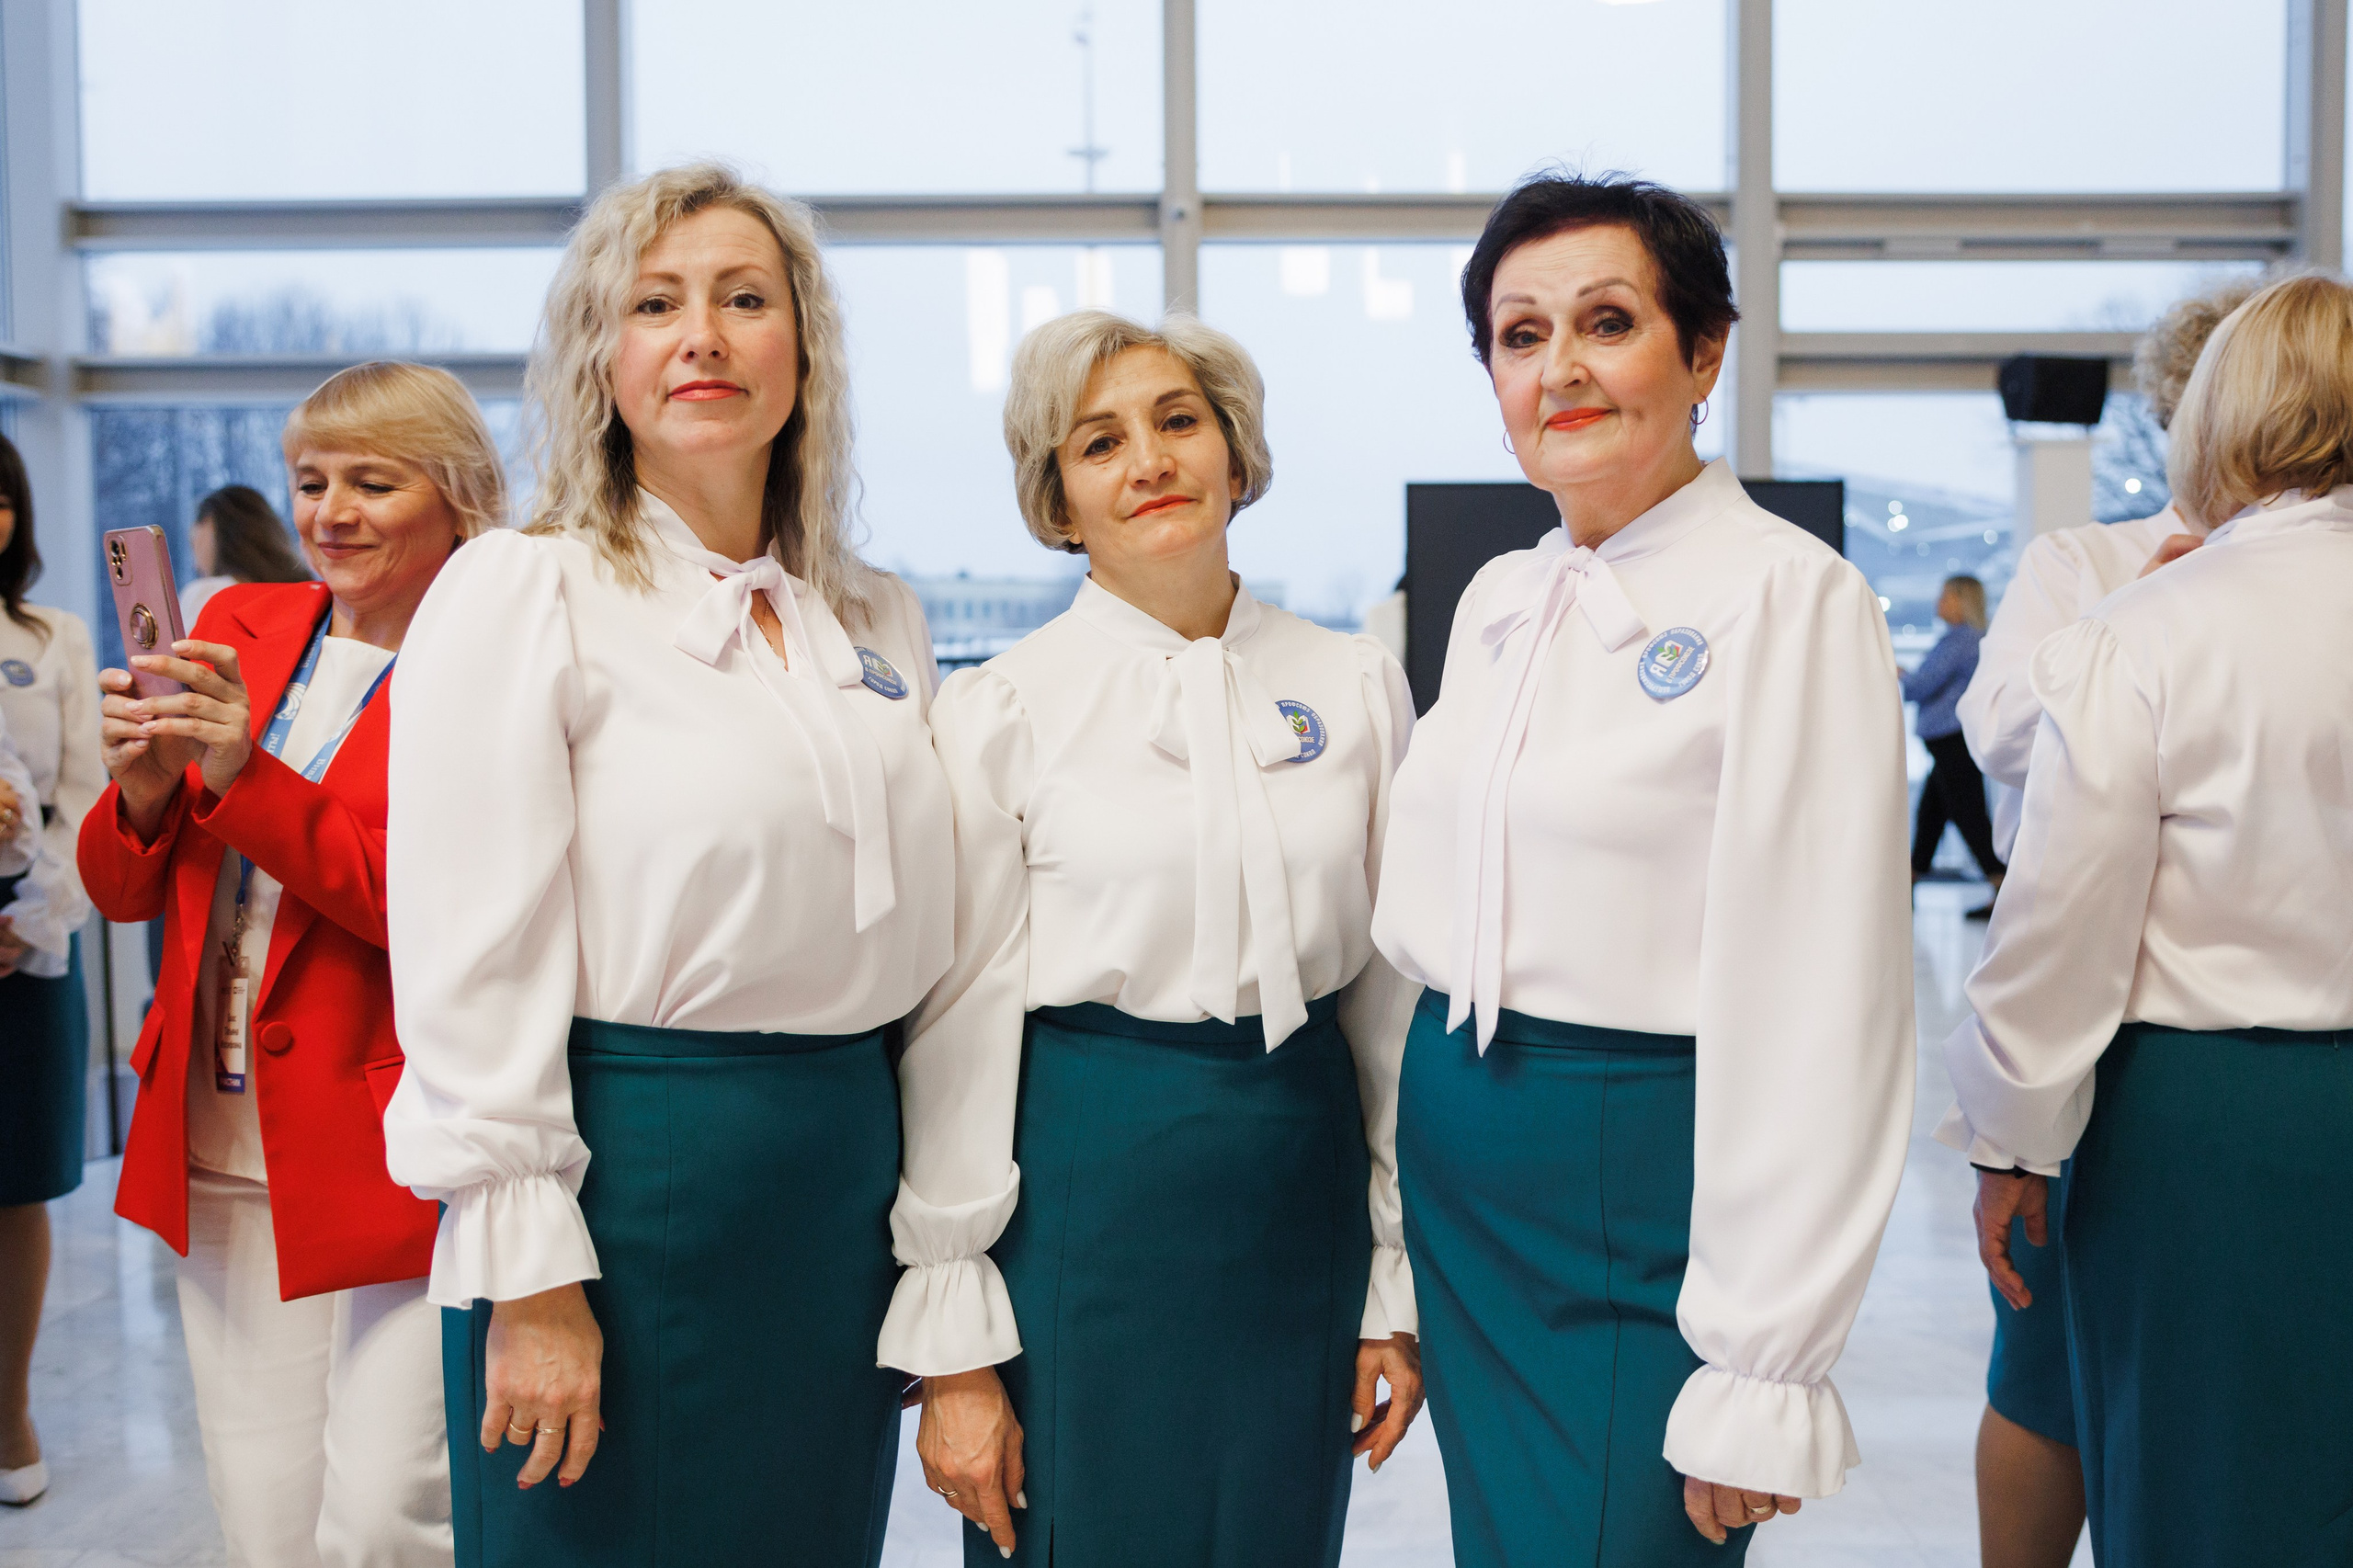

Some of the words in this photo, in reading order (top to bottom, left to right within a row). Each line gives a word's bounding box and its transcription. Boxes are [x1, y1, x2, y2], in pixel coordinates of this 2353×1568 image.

[862, 654, 872, 666] Я
[1650, 663, 1667, 677] Я
[1670, 645, 1695, 678] ПРОФСОЮЗЕ
[1280, 701, 1311, 713] ПРОФСОЮЗ
[1311, 712, 1325, 746] ОБРАЗОВАНИЯ
